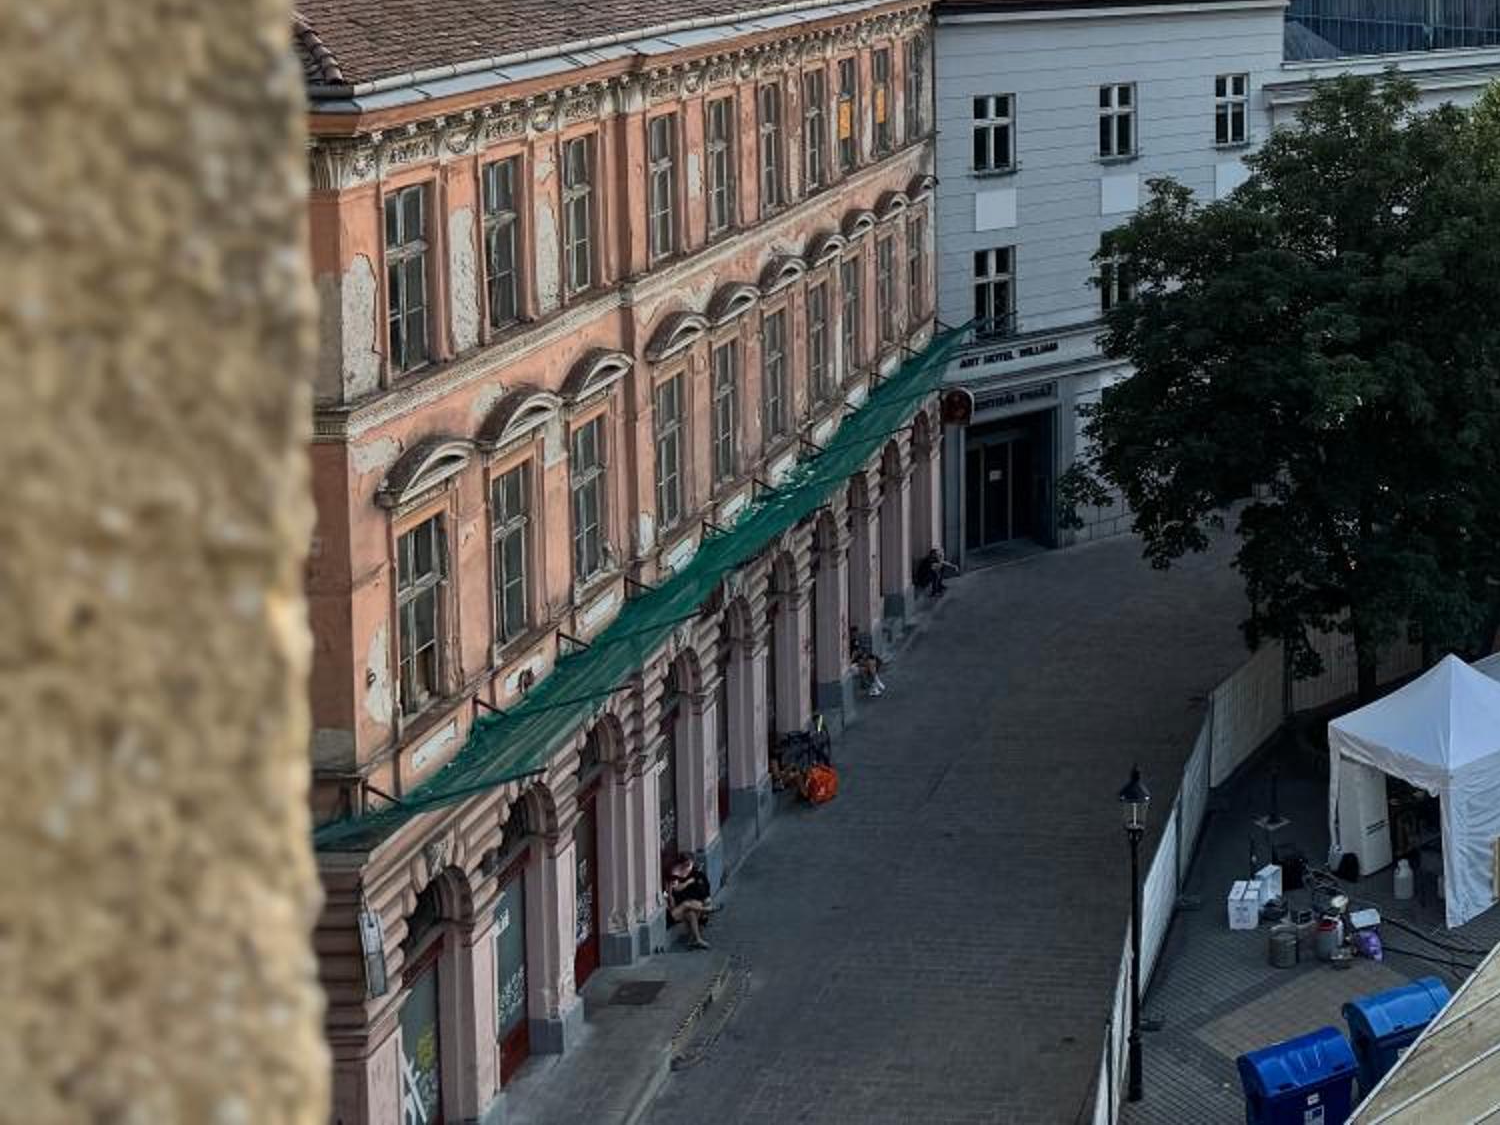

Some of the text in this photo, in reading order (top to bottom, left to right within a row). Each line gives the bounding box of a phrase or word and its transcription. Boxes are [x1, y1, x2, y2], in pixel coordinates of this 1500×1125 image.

[959, 341, 1058, 369] ART HOTEL WILLIAM
